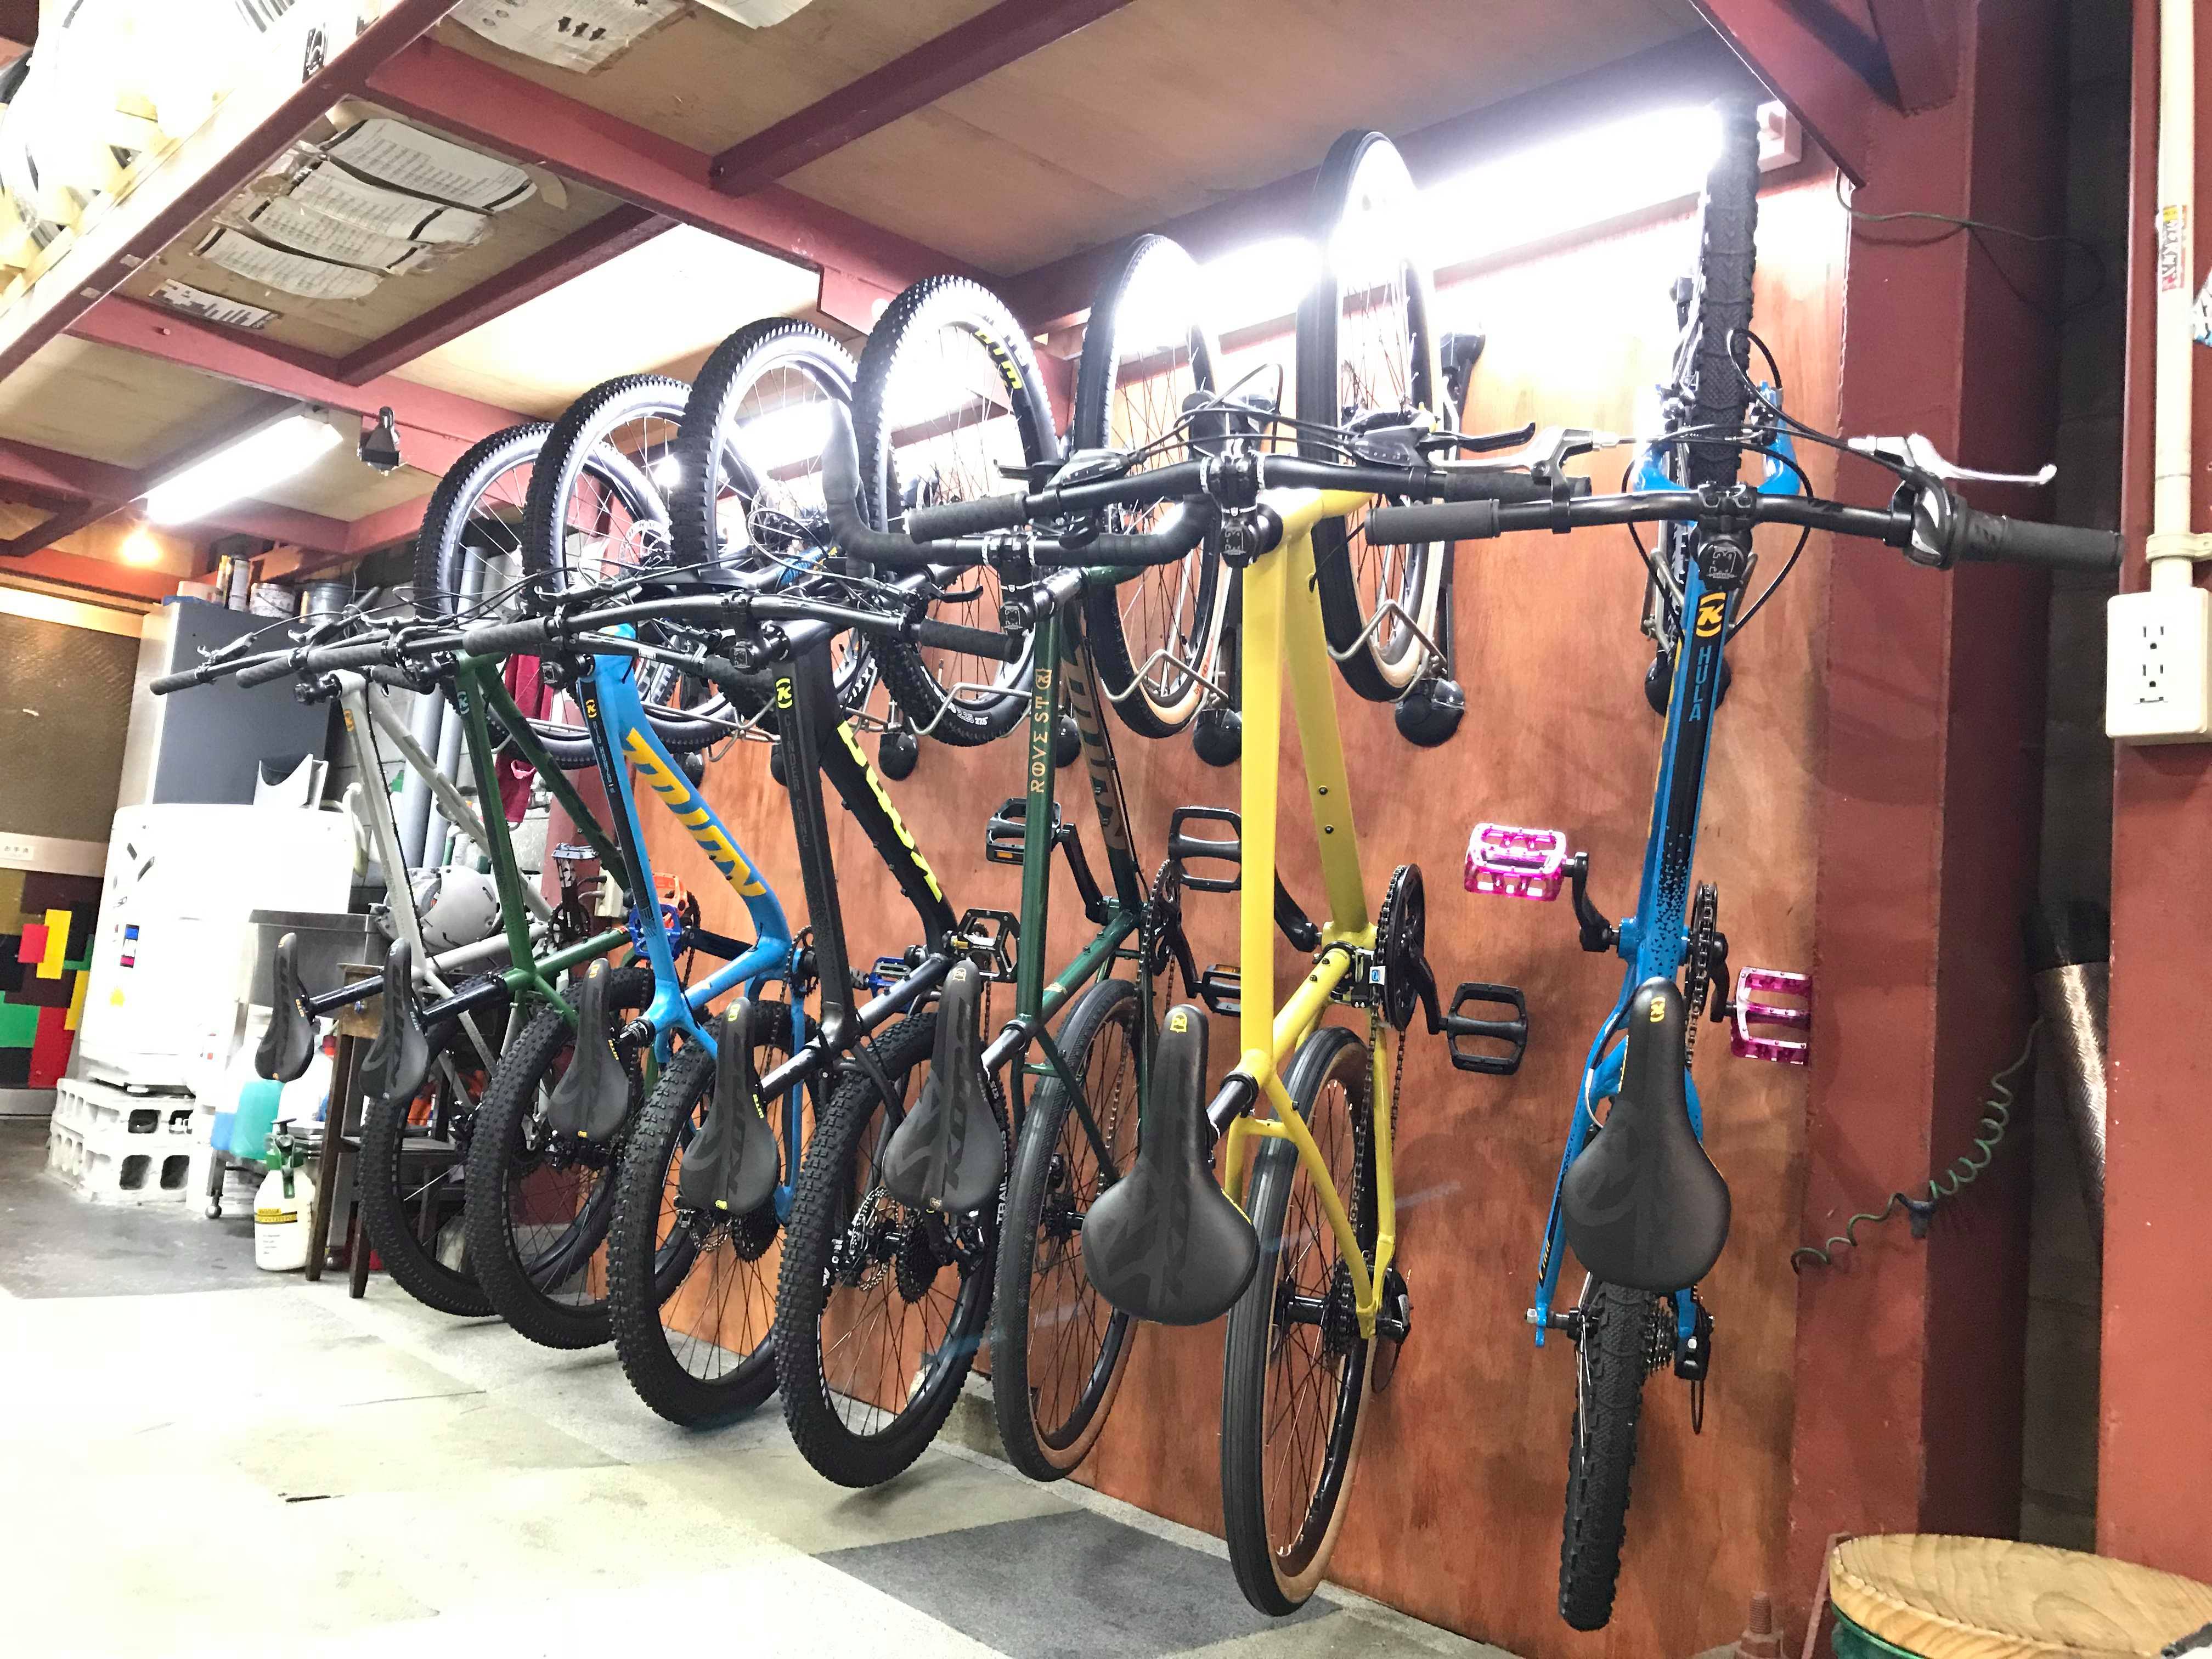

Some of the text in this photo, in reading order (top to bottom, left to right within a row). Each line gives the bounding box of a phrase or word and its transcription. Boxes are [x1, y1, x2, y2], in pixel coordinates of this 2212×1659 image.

[1689, 645, 1712, 722] HULA
[592, 720, 602, 744] BIG
[1030, 695, 1049, 793] ROVE ST
[795, 798, 810, 848] CONE
[996, 1175, 1008, 1225] TRAIL
